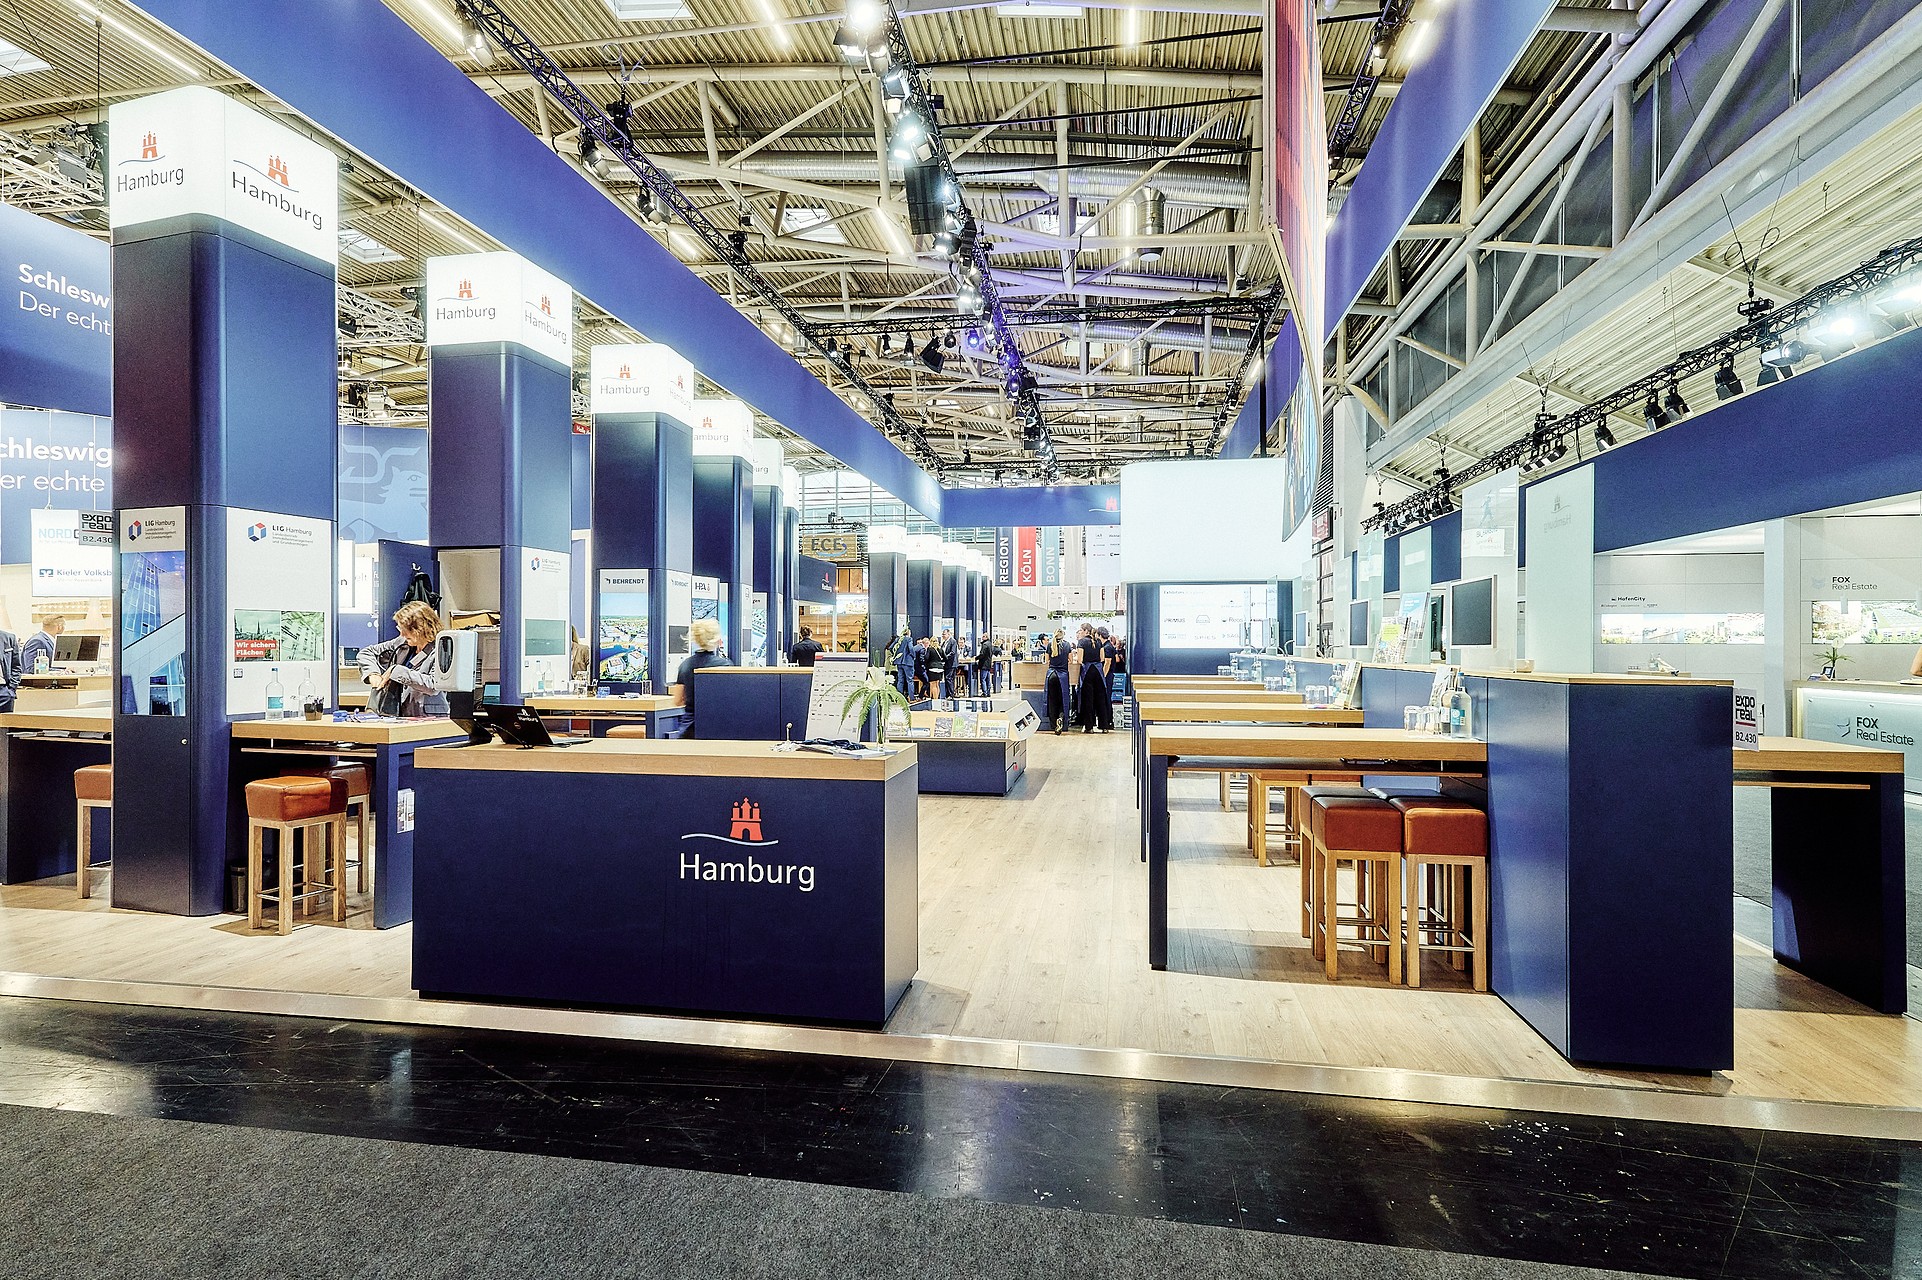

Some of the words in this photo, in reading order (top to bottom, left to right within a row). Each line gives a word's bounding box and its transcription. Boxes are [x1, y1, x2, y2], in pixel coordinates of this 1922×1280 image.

[117, 166, 185, 193] Hamburg
[231, 170, 323, 230] Hamburg
[18, 263, 110, 309] Schlesw
[19, 290, 61, 319] Der
[66, 311, 111, 336] echt
[436, 305, 496, 320] Hamburg
[524, 309, 567, 344] Hamburg
[600, 384, 650, 396] Hamburg
[33, 469, 105, 492] echte
[81, 513, 113, 524] expo
[82, 535, 112, 543] B2.430
[285, 526, 312, 536] Hamburg
[811, 537, 844, 551] ECE
[1000, 537, 1009, 583] REGION
[1020, 549, 1032, 582] KÖLN
[1046, 546, 1055, 582] BONN
[1735, 695, 1756, 713] expo
[1735, 708, 1756, 722] real
[1856, 716, 1879, 729] FOX
[1735, 731, 1757, 744] B2.430
[1856, 729, 1878, 742] Real
[1880, 731, 1914, 746] Estate
[679, 852, 816, 893] Hamburg
